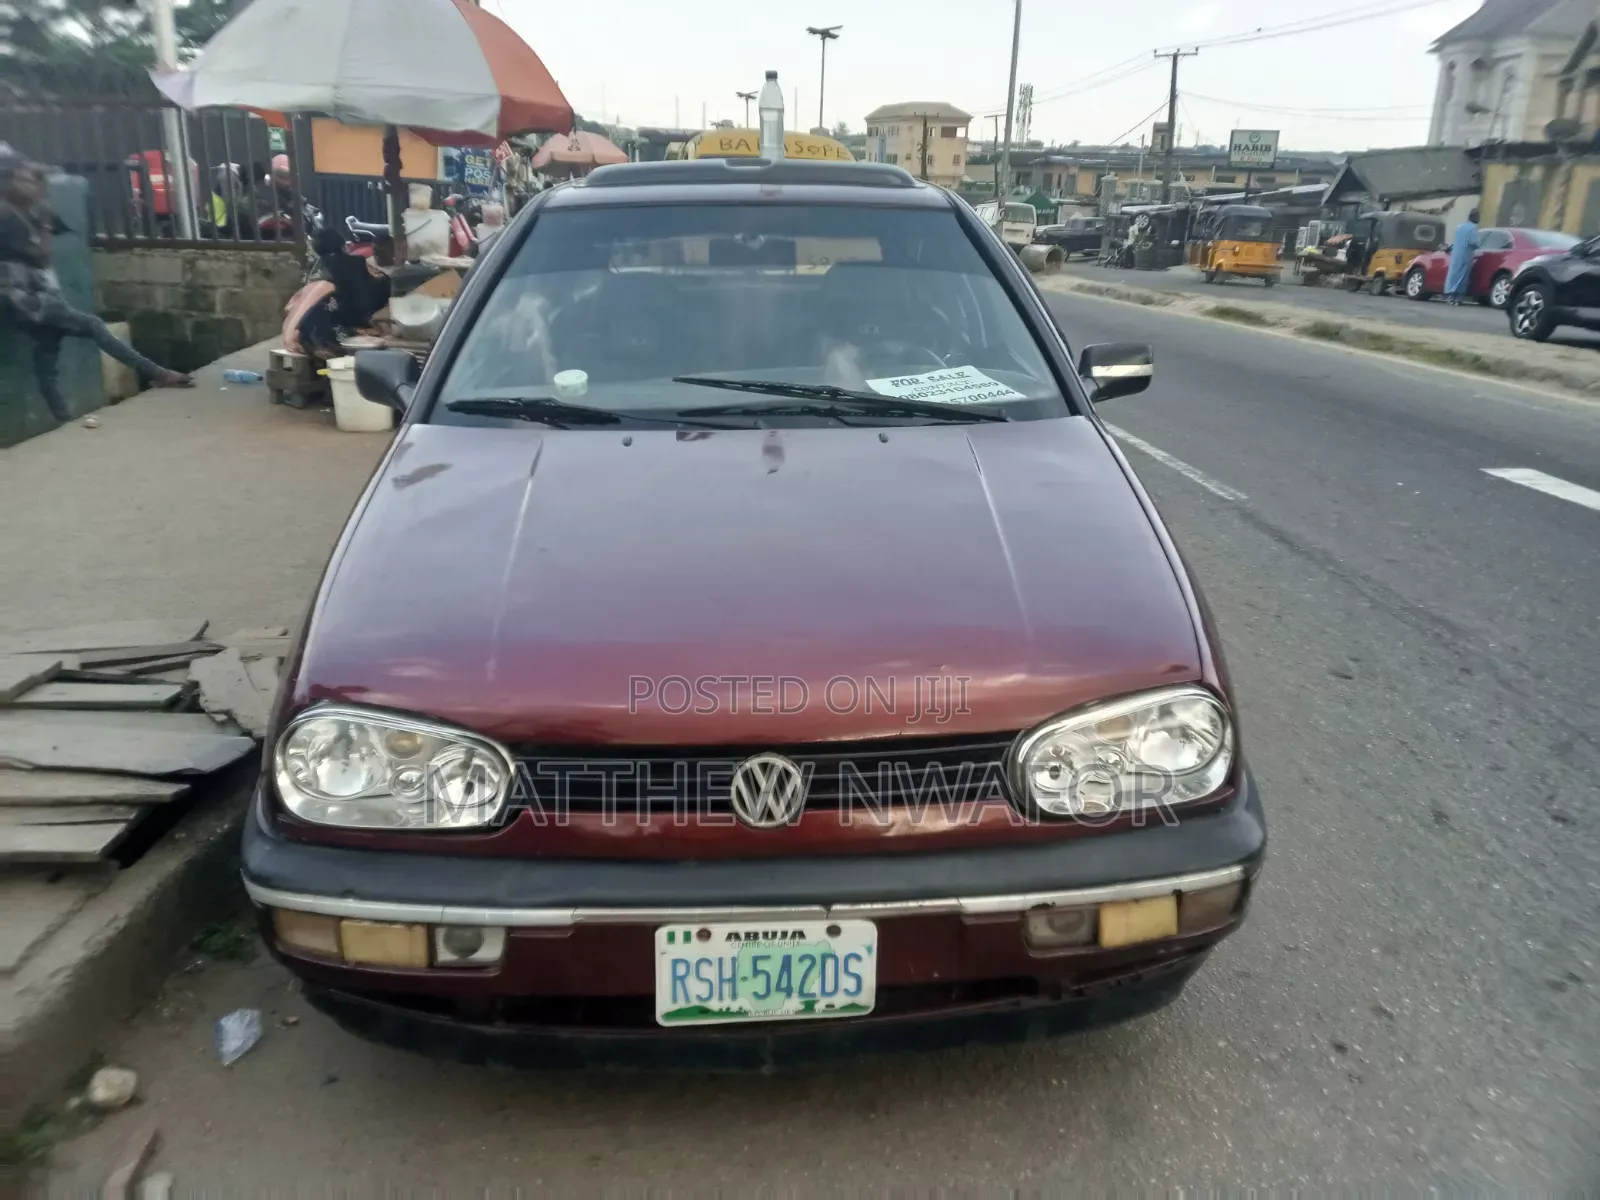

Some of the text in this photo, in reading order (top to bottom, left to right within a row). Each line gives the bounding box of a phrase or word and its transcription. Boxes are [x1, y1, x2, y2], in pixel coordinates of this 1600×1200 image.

[1233, 144, 1272, 152] HABIB
[464, 154, 491, 167] GET
[464, 167, 491, 180] POS
[891, 371, 972, 388] FOR SALE
[725, 930, 807, 942] ABUJA
[671, 952, 863, 1004] RSH-542DS
